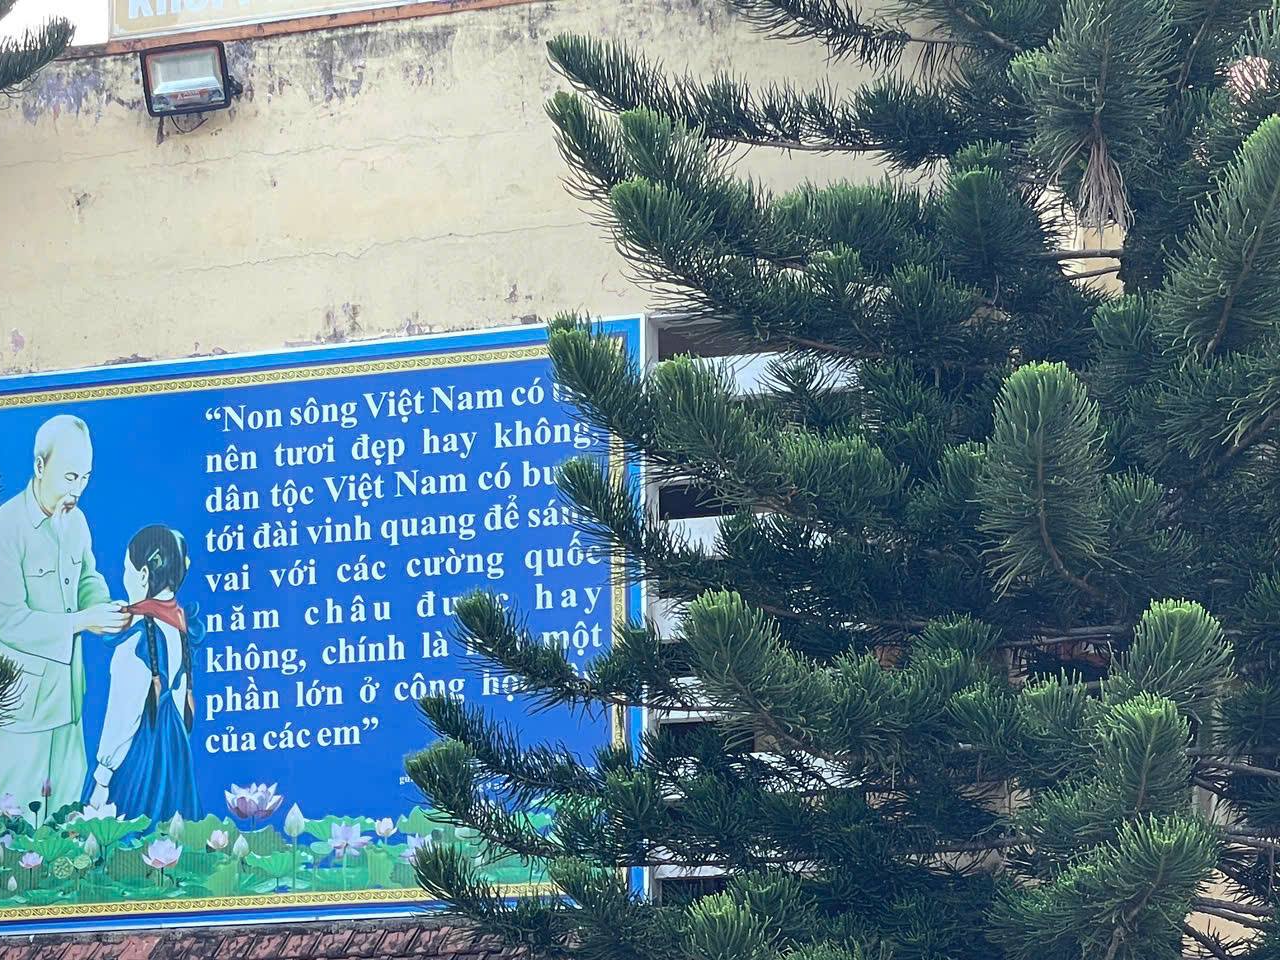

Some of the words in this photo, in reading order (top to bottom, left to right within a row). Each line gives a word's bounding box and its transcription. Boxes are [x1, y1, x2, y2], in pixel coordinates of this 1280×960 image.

[205, 404, 283, 432] “Non
[290, 397, 358, 429] sông
[362, 388, 424, 423] Việt
[431, 385, 504, 413] Nam
[511, 377, 544, 406] có
[206, 444, 258, 473] nên
[274, 436, 336, 467] tươi
[351, 434, 405, 465] đẹp
[423, 429, 477, 459] hay
[494, 417, 600, 449] không,
[205, 484, 259, 513] dân
[270, 479, 314, 513] tộc
[323, 473, 385, 507] Việt
[394, 470, 467, 497] Nam
[478, 462, 511, 490] có
[205, 524, 244, 553] tới
[253, 520, 299, 549] đài
[306, 515, 372, 544] vinh
[380, 511, 476, 545] quang
[484, 495, 519, 531] để
[527, 499, 588, 527] sán
[205, 564, 250, 593] vai
[269, 559, 317, 588] với
[336, 554, 386, 583] các
[406, 548, 505, 579] cường
[524, 530, 601, 577] quốc
[206, 604, 280, 633] năm
[304, 594, 391, 625] châu
[416, 590, 509, 618] đưc
[535, 583, 603, 615] hay
[206, 642, 307, 675] không,
[322, 634, 406, 665] chính
[422, 631, 449, 659] là
[542, 621, 603, 656] một
[205, 676, 280, 721] phần
[295, 679, 343, 708] lớn
[359, 676, 380, 704] ở
[394, 672, 466, 703] công
[205, 725, 256, 753] của
[263, 721, 311, 750] các
[317, 716, 379, 747] em”
